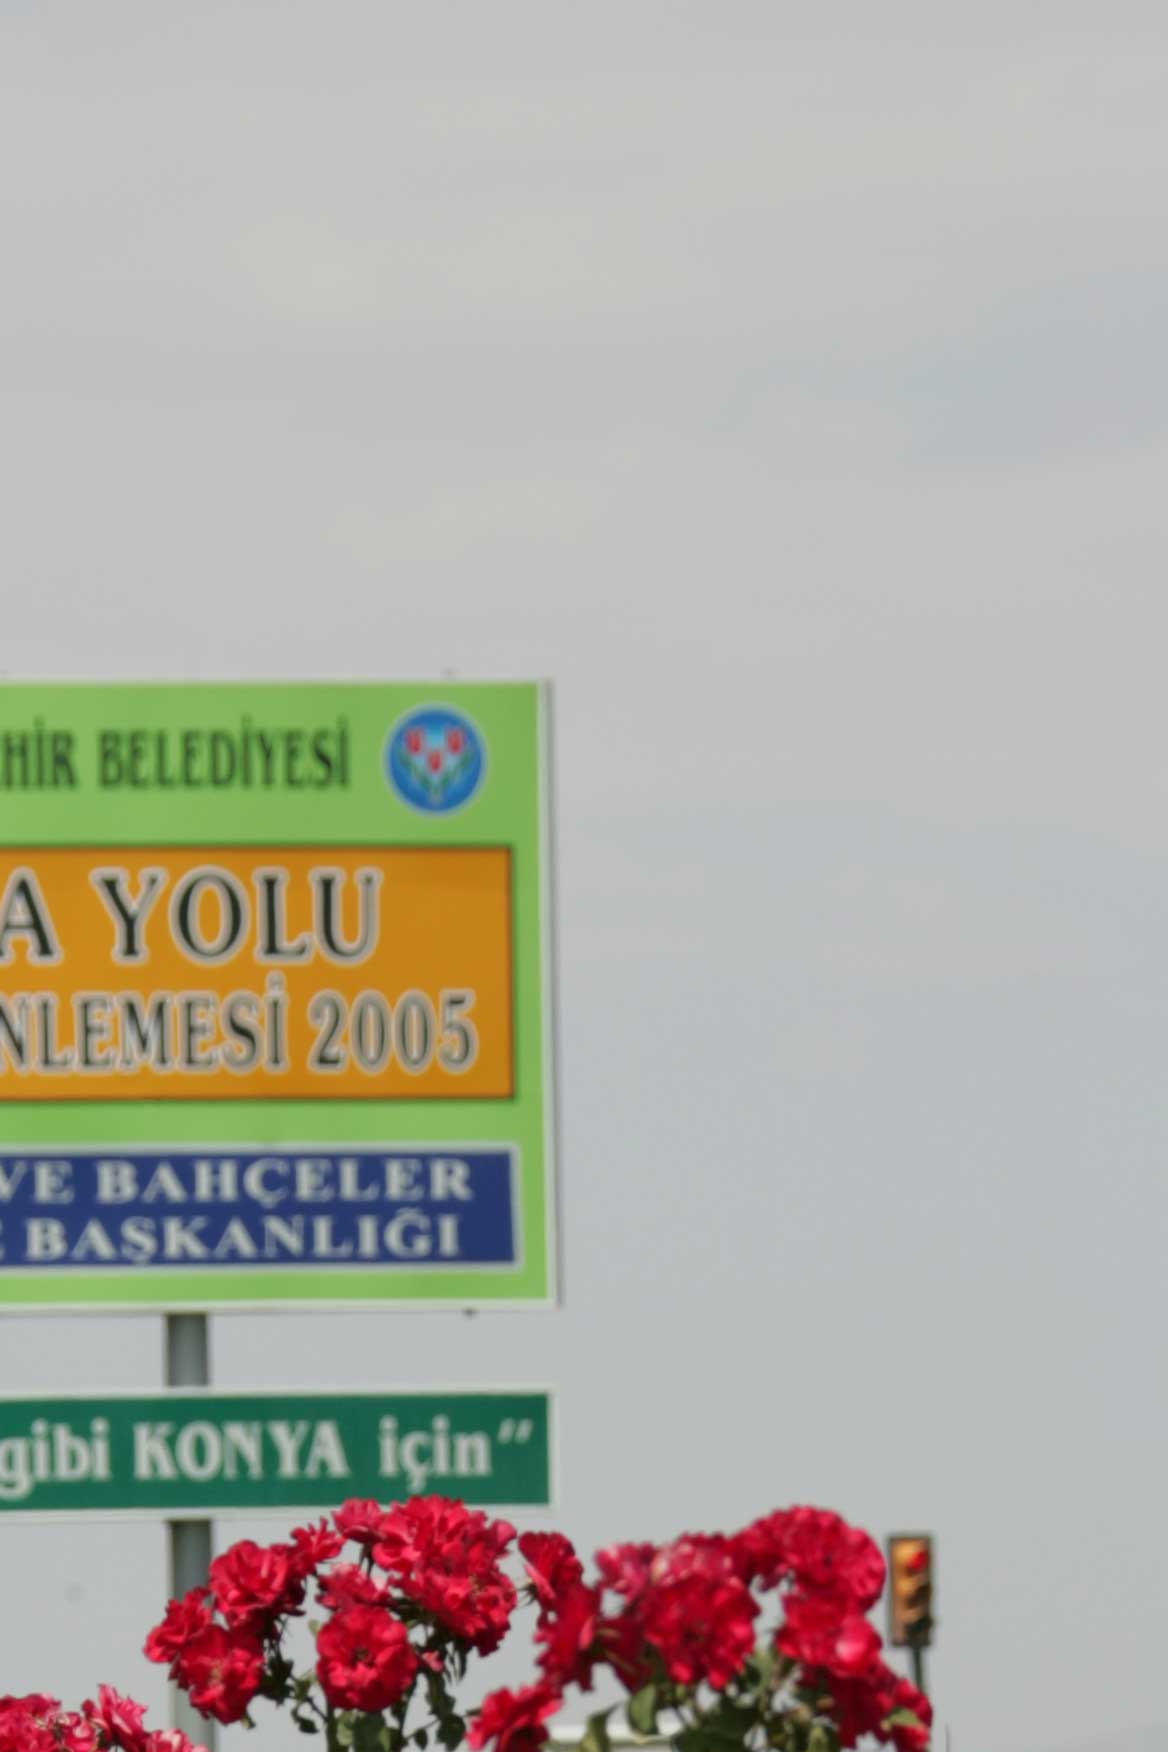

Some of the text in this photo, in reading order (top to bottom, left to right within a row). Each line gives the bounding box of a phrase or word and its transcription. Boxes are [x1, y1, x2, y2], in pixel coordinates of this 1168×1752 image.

[98, 714, 351, 792] BELEDİYESİ
[90, 864, 384, 966] YOLU
[307, 988, 480, 1075] 2005
[95, 1157, 474, 1209] BAHÇELER
[24, 1206, 460, 1266] BAŞKANLIĞI
[133, 1420, 351, 1481] KONYA
